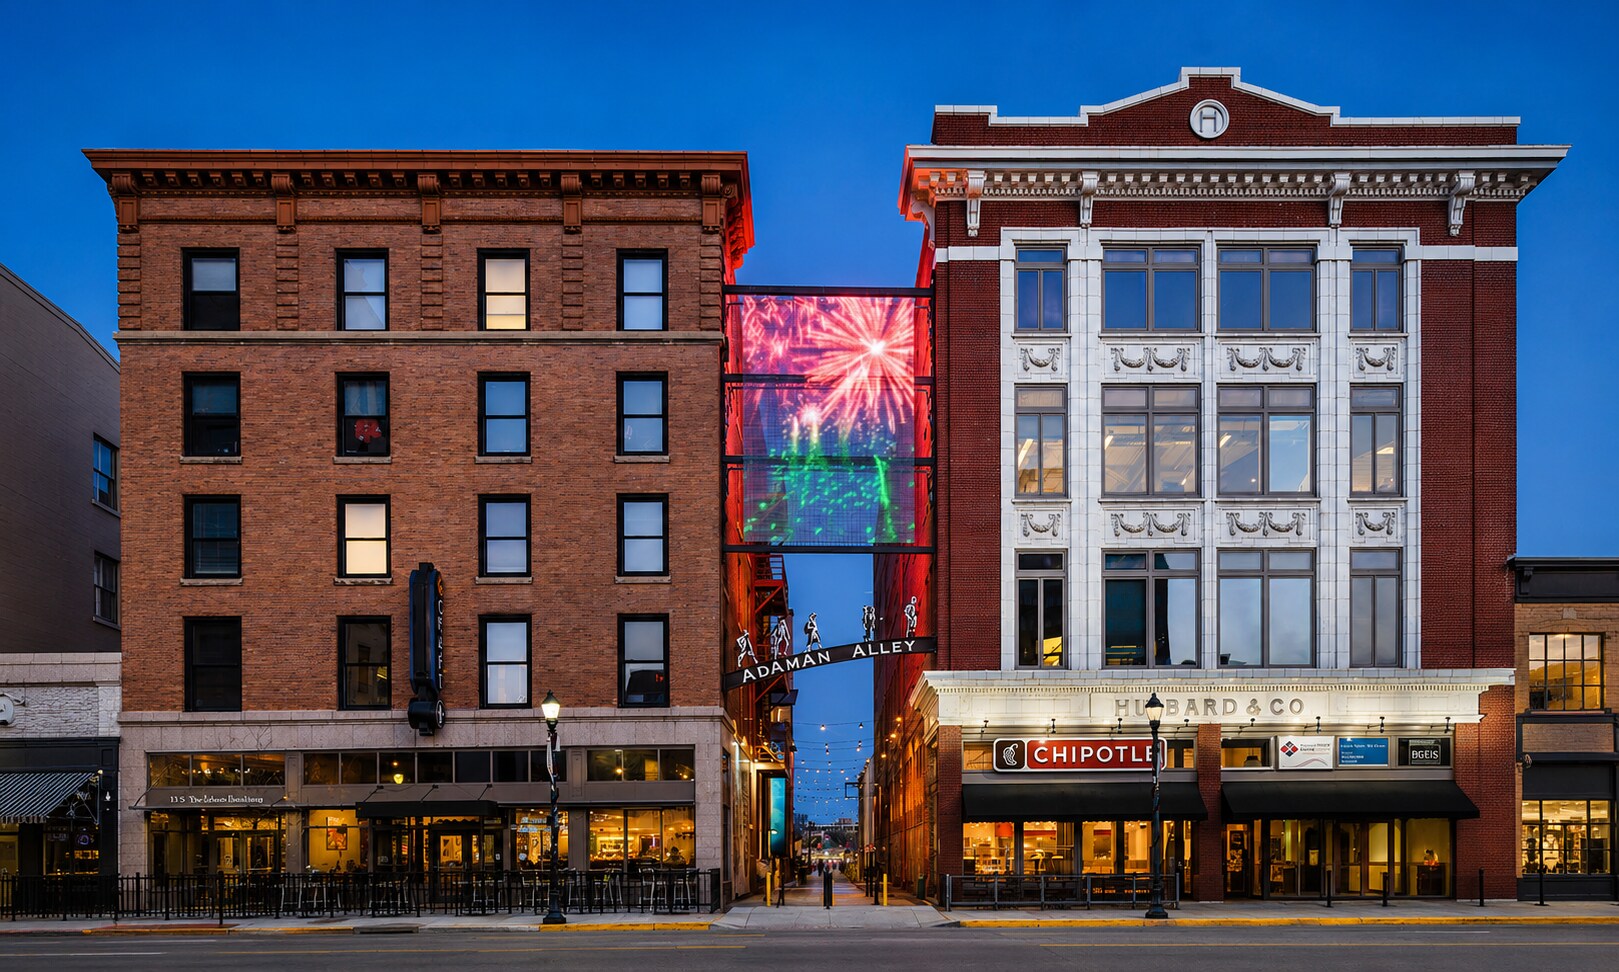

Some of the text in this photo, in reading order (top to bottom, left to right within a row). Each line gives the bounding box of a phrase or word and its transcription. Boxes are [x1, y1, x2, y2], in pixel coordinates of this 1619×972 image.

[742, 640, 916, 683] ADAMAN ALLEY
[1114, 698, 1305, 717] HUBARD & CO
